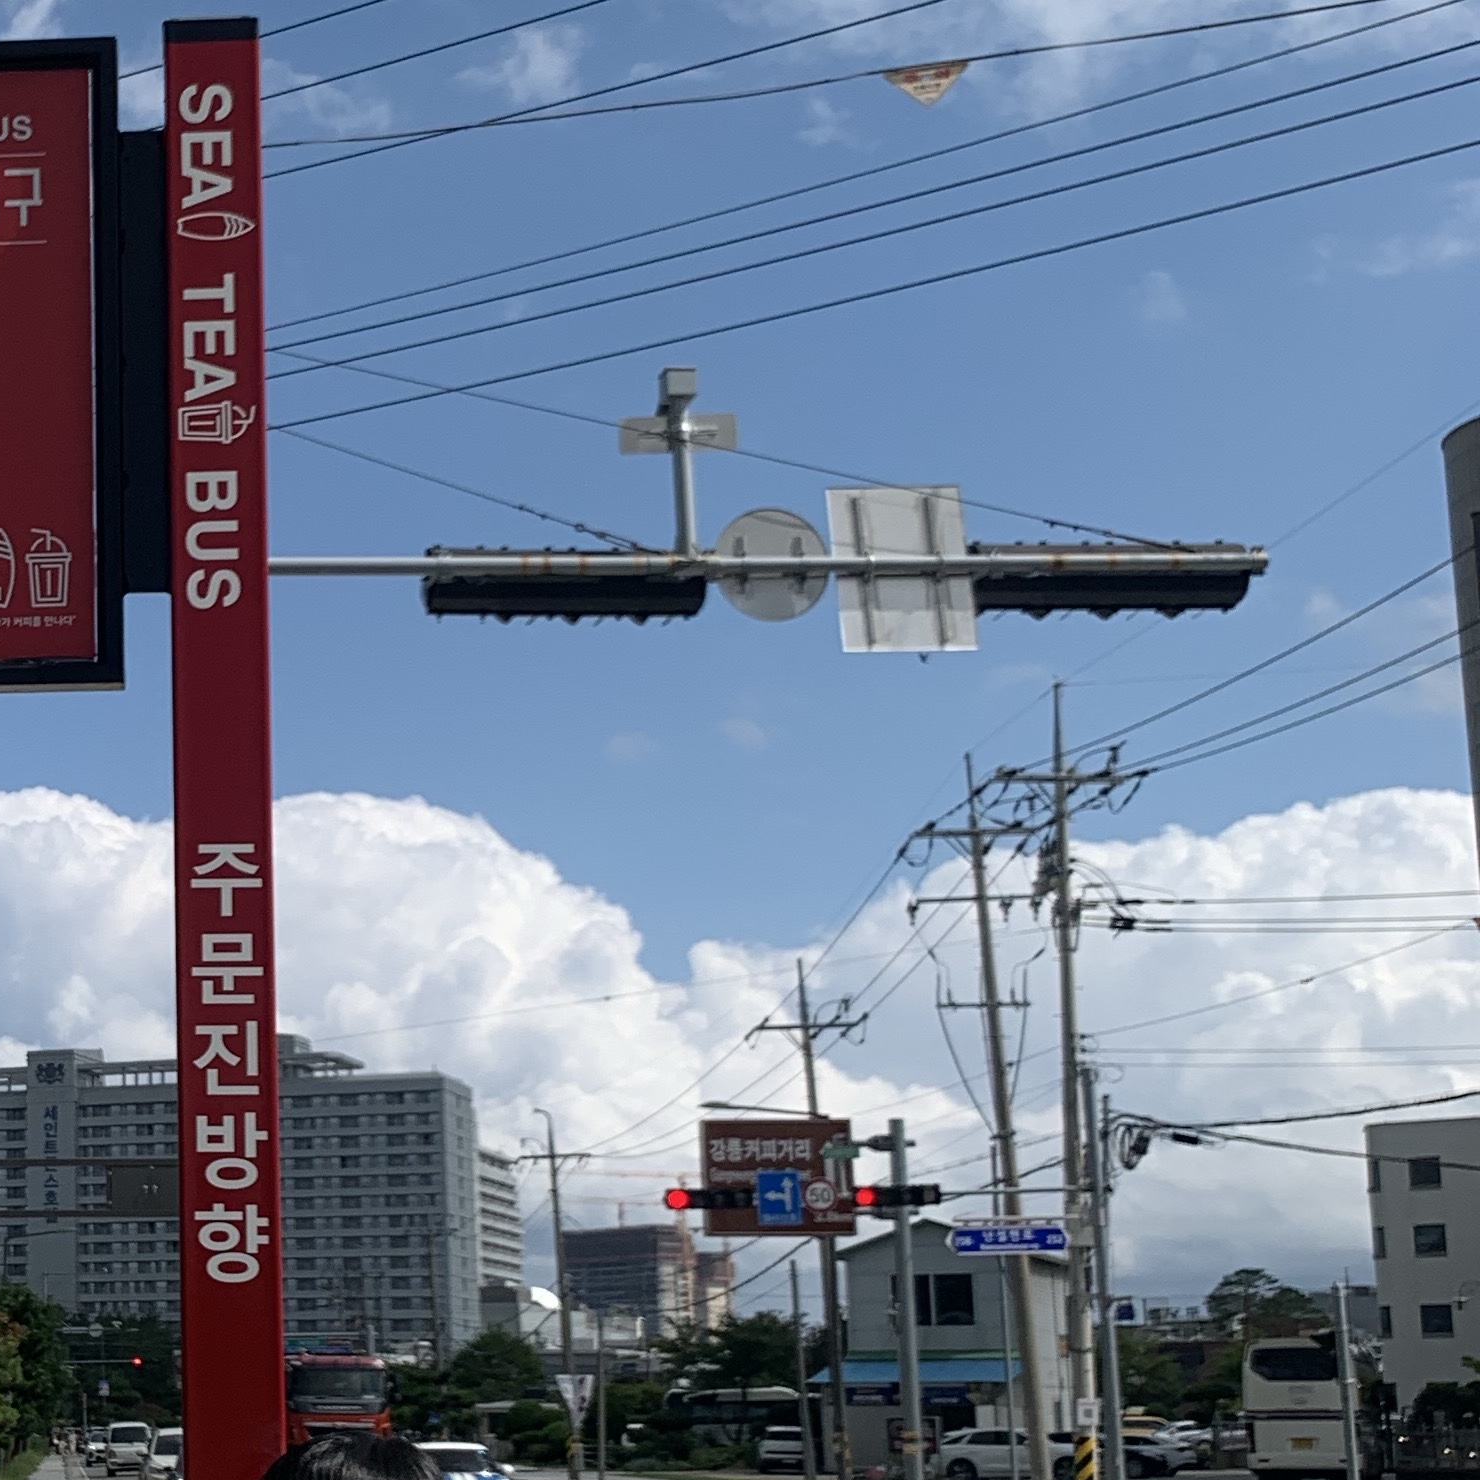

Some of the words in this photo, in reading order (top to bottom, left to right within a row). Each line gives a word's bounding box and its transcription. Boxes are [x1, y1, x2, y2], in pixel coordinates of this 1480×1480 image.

[179, 84, 233, 209] SEA
[183, 273, 237, 402] TEA
[185, 470, 242, 609] BUS
[710, 1137, 812, 1163] 강릉커피거리
[809, 1187, 831, 1203] 50
